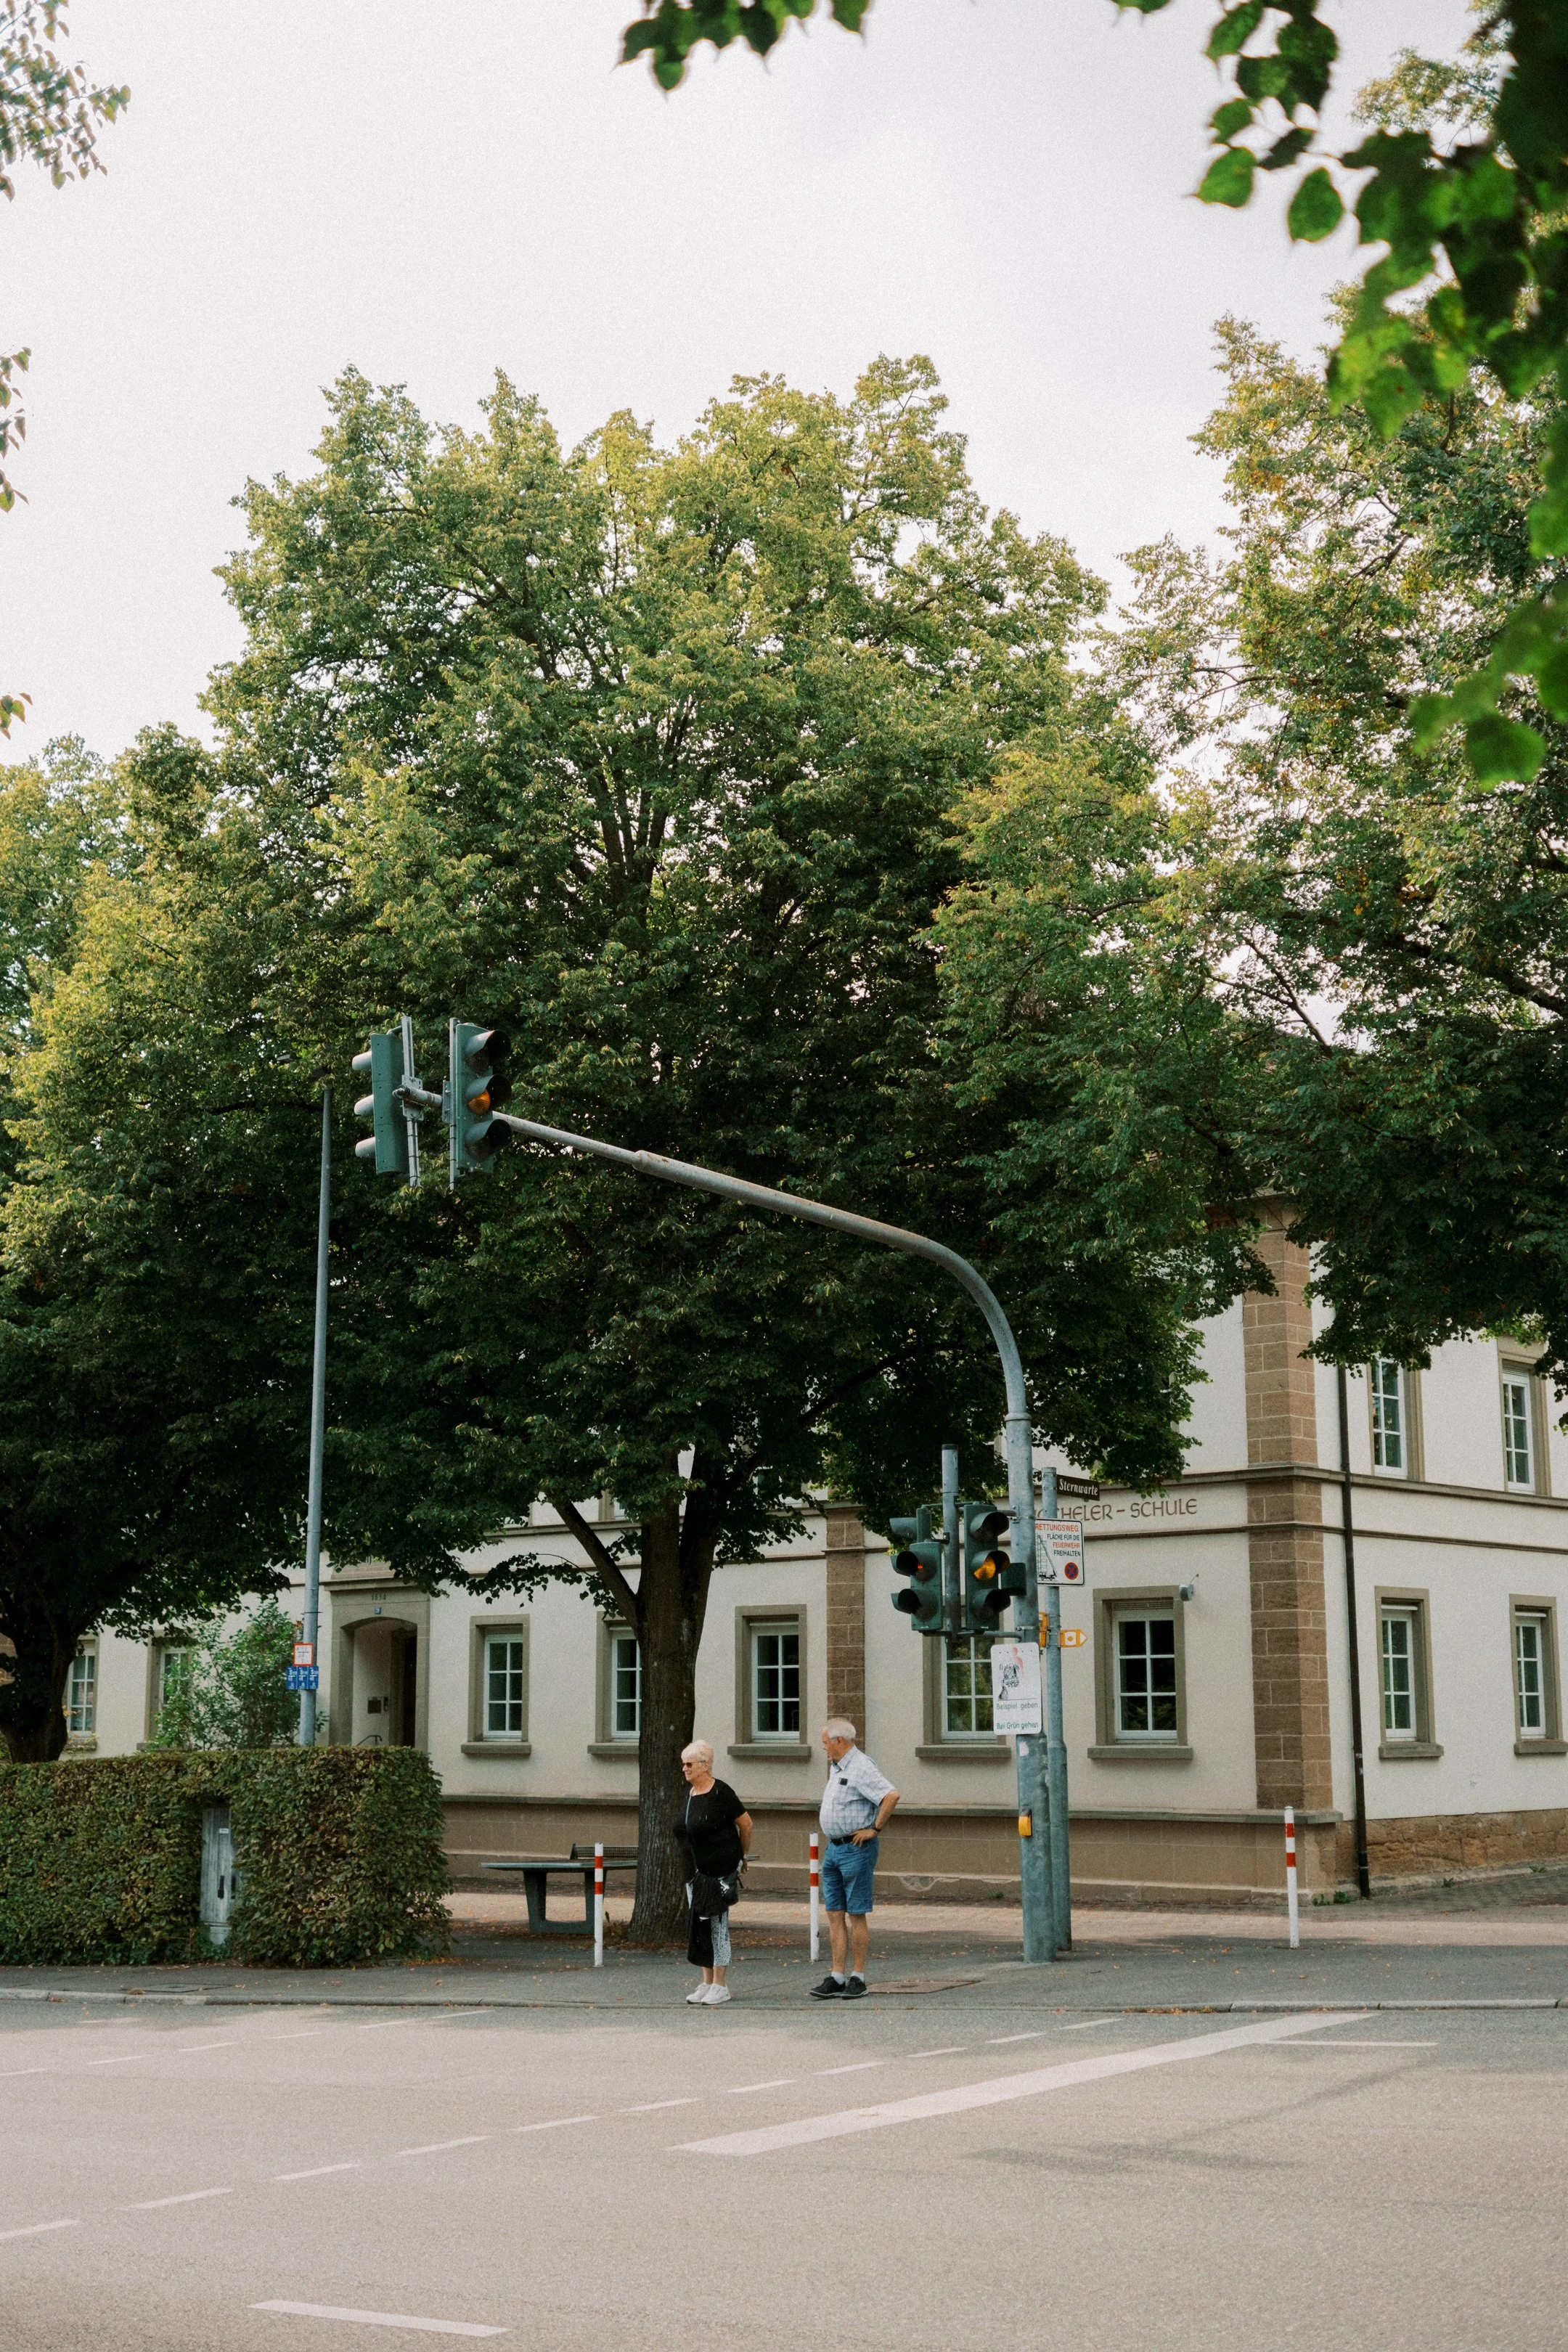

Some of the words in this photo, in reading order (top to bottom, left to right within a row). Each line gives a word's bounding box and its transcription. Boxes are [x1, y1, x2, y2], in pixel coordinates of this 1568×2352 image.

[1059, 1478, 1098, 1495] Sternwarte
[1130, 1498, 1197, 1518] SCHULE
[1034, 1523, 1079, 1532] RETTUNGSWEG
[1021, 1702, 1038, 1710] geben
[1021, 1721, 1039, 1730] gehen
